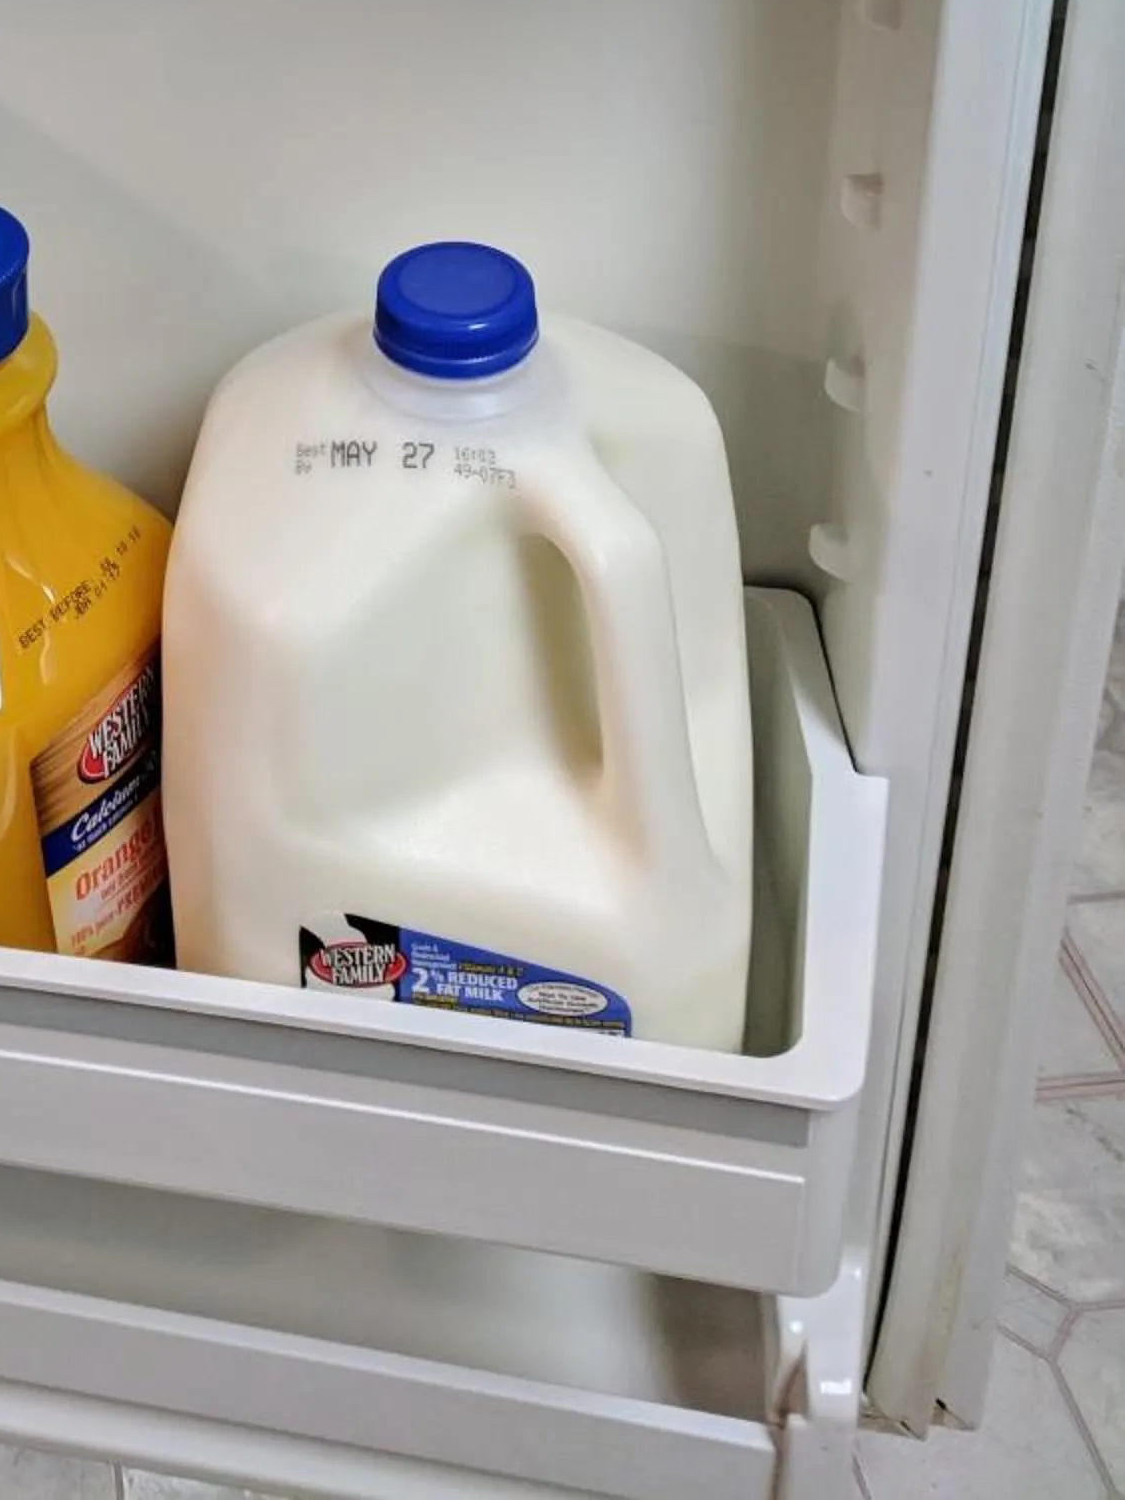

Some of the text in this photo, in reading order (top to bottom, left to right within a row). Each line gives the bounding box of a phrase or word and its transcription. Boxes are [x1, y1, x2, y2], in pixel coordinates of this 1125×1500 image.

[331, 440, 377, 469] MAY
[402, 441, 436, 469] 27
[18, 619, 46, 649] BEST
[319, 943, 395, 968] WESTERN
[332, 962, 386, 985] FAMILY
[448, 971, 518, 990] REDUCED
[436, 983, 461, 997] FAT
[464, 985, 504, 1001] MILK
